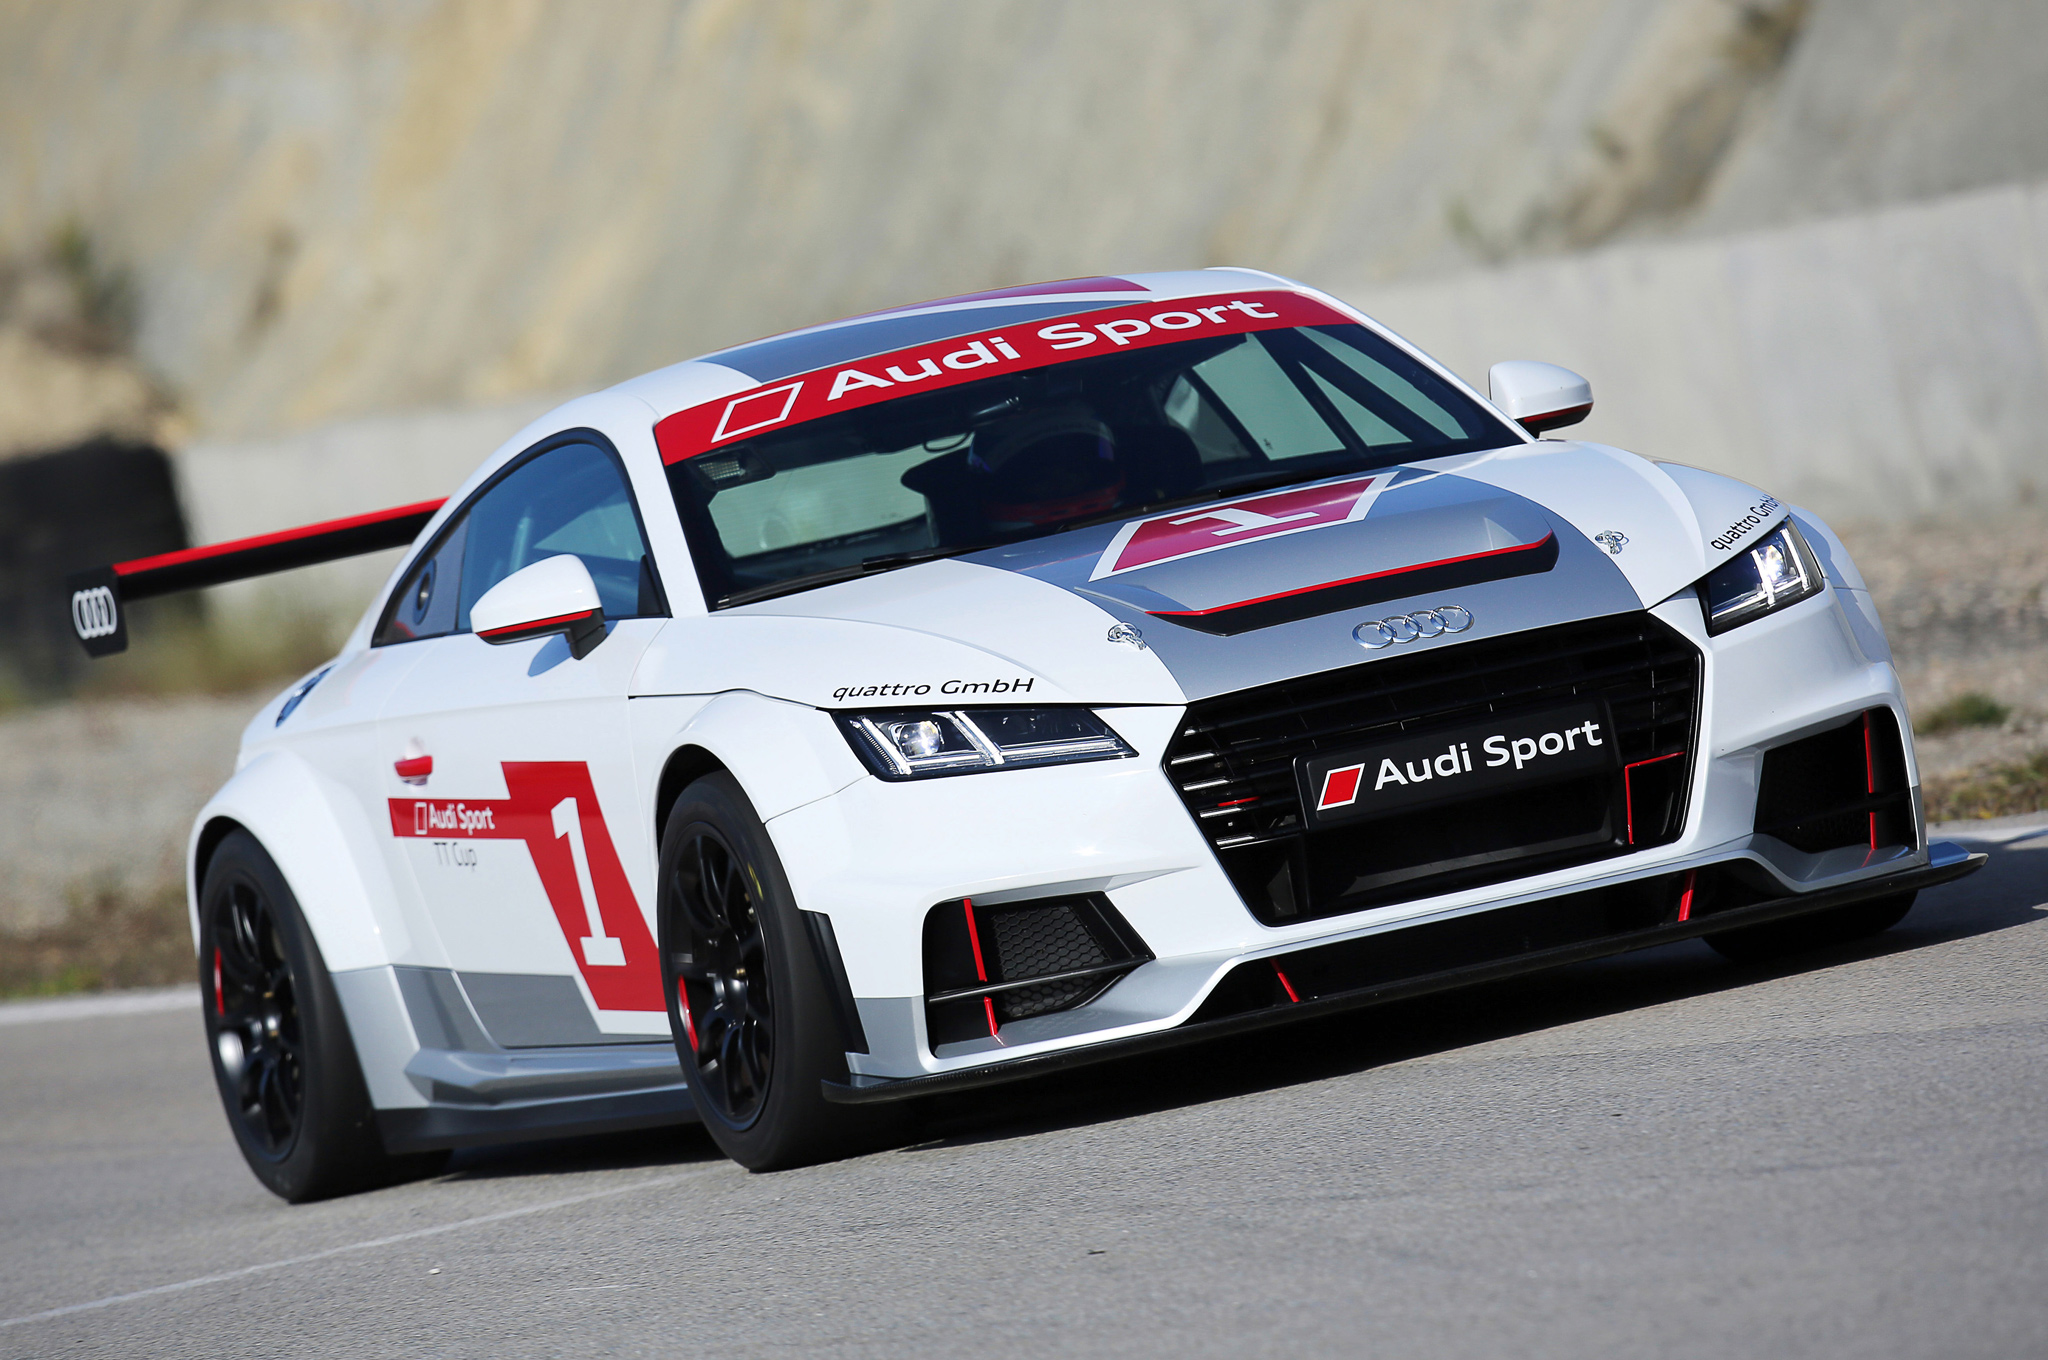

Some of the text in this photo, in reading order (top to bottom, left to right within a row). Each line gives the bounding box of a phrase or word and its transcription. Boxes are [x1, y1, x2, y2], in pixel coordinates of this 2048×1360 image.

[827, 298, 1280, 401] Audi Sport
[1168, 507, 1320, 537] 1
[1710, 515, 1761, 551] quattro
[832, 677, 1035, 702] quattro GmbH
[1374, 720, 1603, 791] Audi Sport
[429, 803, 495, 835] Audi Sport
[433, 842, 477, 871] TT Cup
[551, 797, 627, 966] 1
